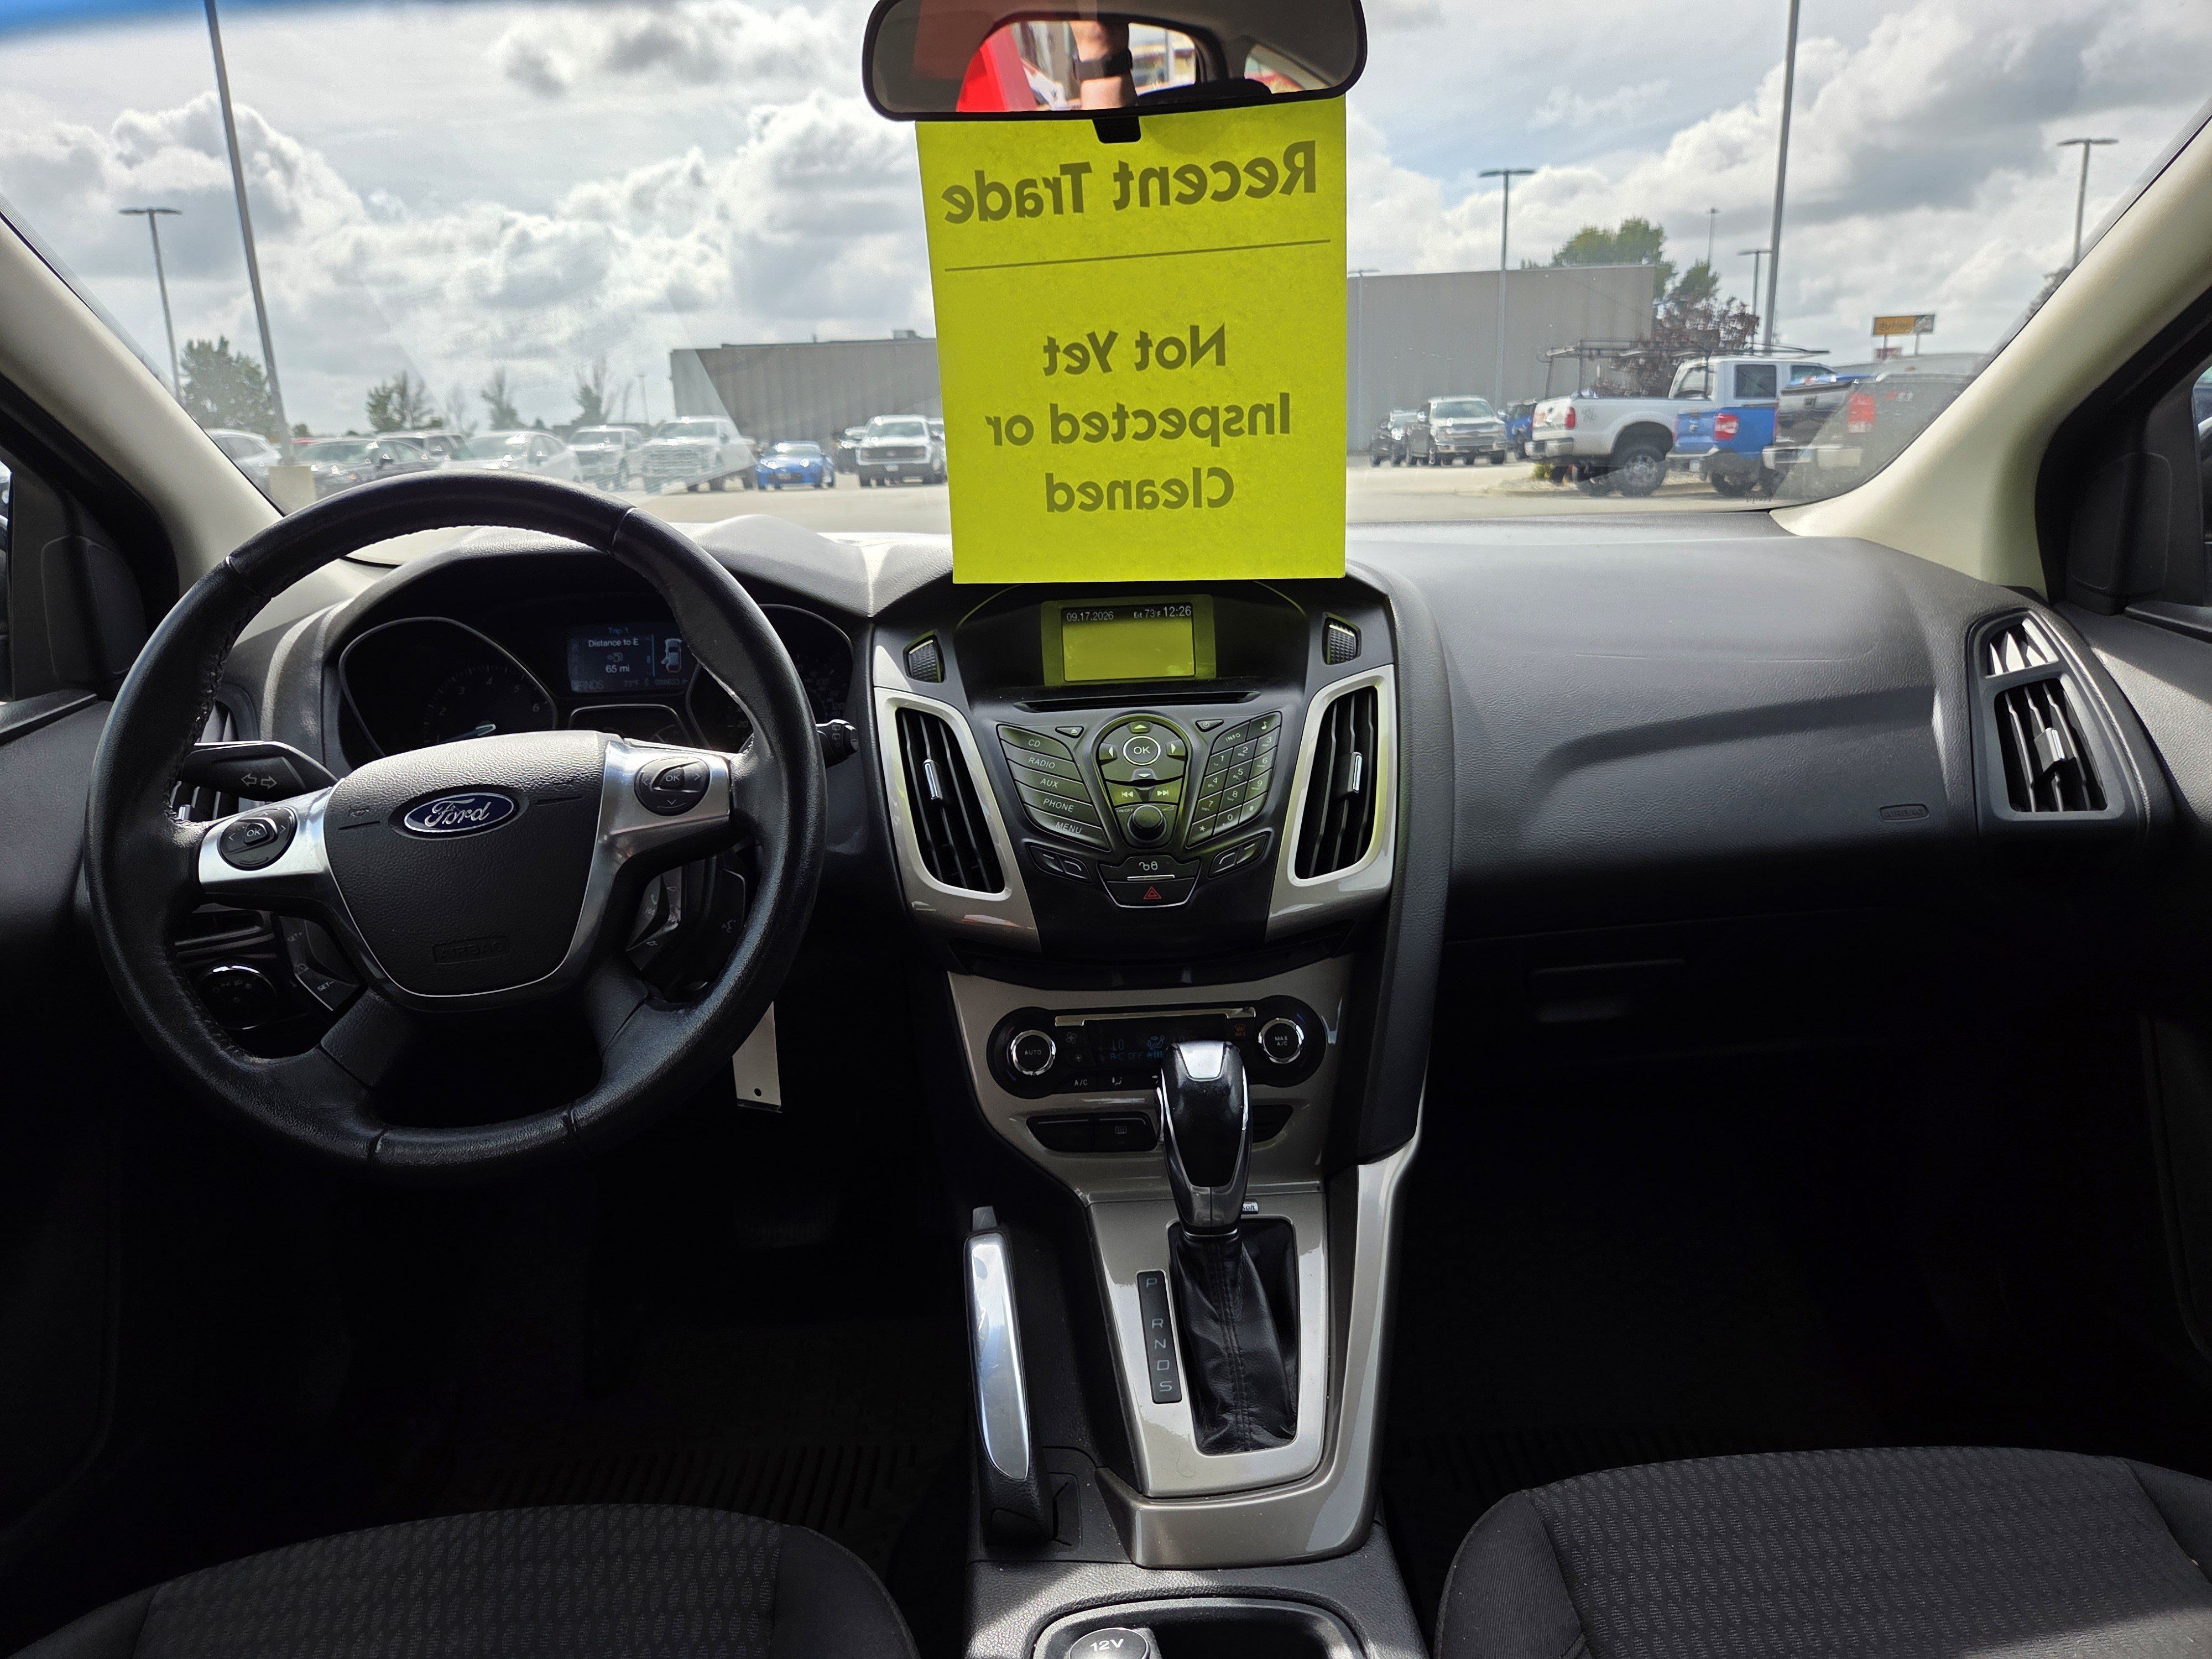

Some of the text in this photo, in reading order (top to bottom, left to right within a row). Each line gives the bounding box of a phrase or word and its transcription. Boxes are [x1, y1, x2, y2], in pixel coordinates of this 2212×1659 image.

[1066, 611, 1114, 622] 09.17.2026
[1163, 606, 1192, 617] 12:26
[588, 639, 622, 648] Distance
[606, 664, 630, 673] 65 mi
[1225, 733, 1241, 742] INFO
[1028, 739, 1041, 748] CD
[1133, 746, 1150, 754] OK
[1028, 757, 1056, 769] RADIO
[1040, 778, 1059, 789] AUX
[1043, 798, 1074, 812] PHONE
[424, 798, 492, 827] Ford
[246, 828, 262, 837] OK
[1055, 821, 1082, 834] MENU
[1146, 1277, 1157, 1288] P
[1152, 1318, 1164, 1329] R
[1155, 1338, 1166, 1349] N
[1157, 1360, 1170, 1371] D
[1159, 1380, 1172, 1392] S
[1091, 1639, 1124, 1652] 12V
